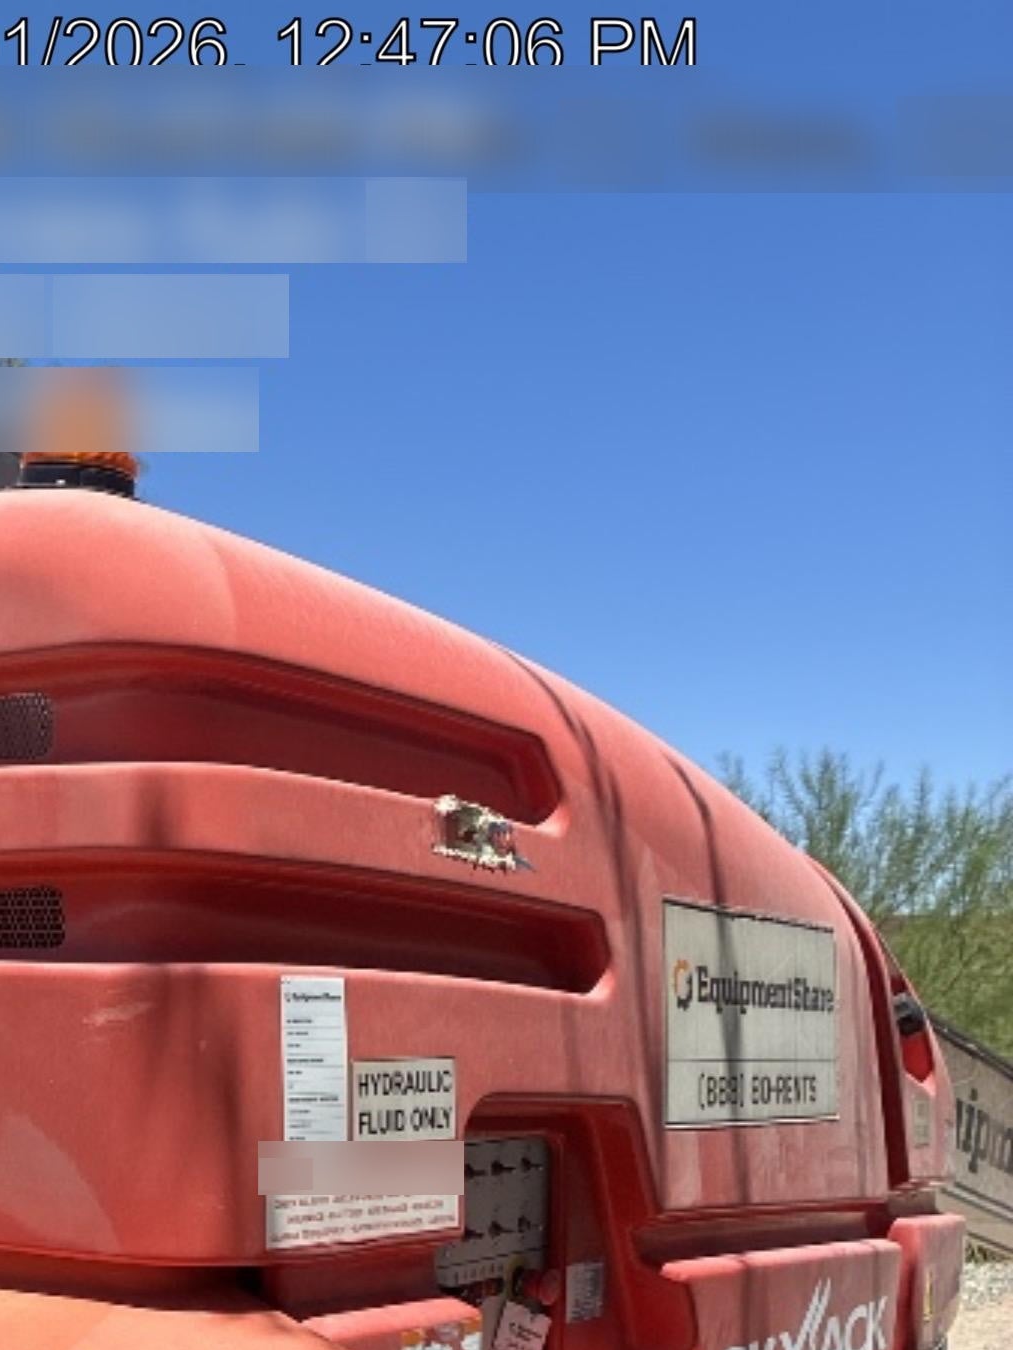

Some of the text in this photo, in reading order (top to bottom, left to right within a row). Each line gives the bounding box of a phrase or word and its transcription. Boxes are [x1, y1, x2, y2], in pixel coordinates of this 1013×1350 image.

[696, 966, 834, 1014] EquipmentShare
[357, 1069, 453, 1098] HYDRAULIC
[358, 1105, 452, 1136] FLUID ONLY
